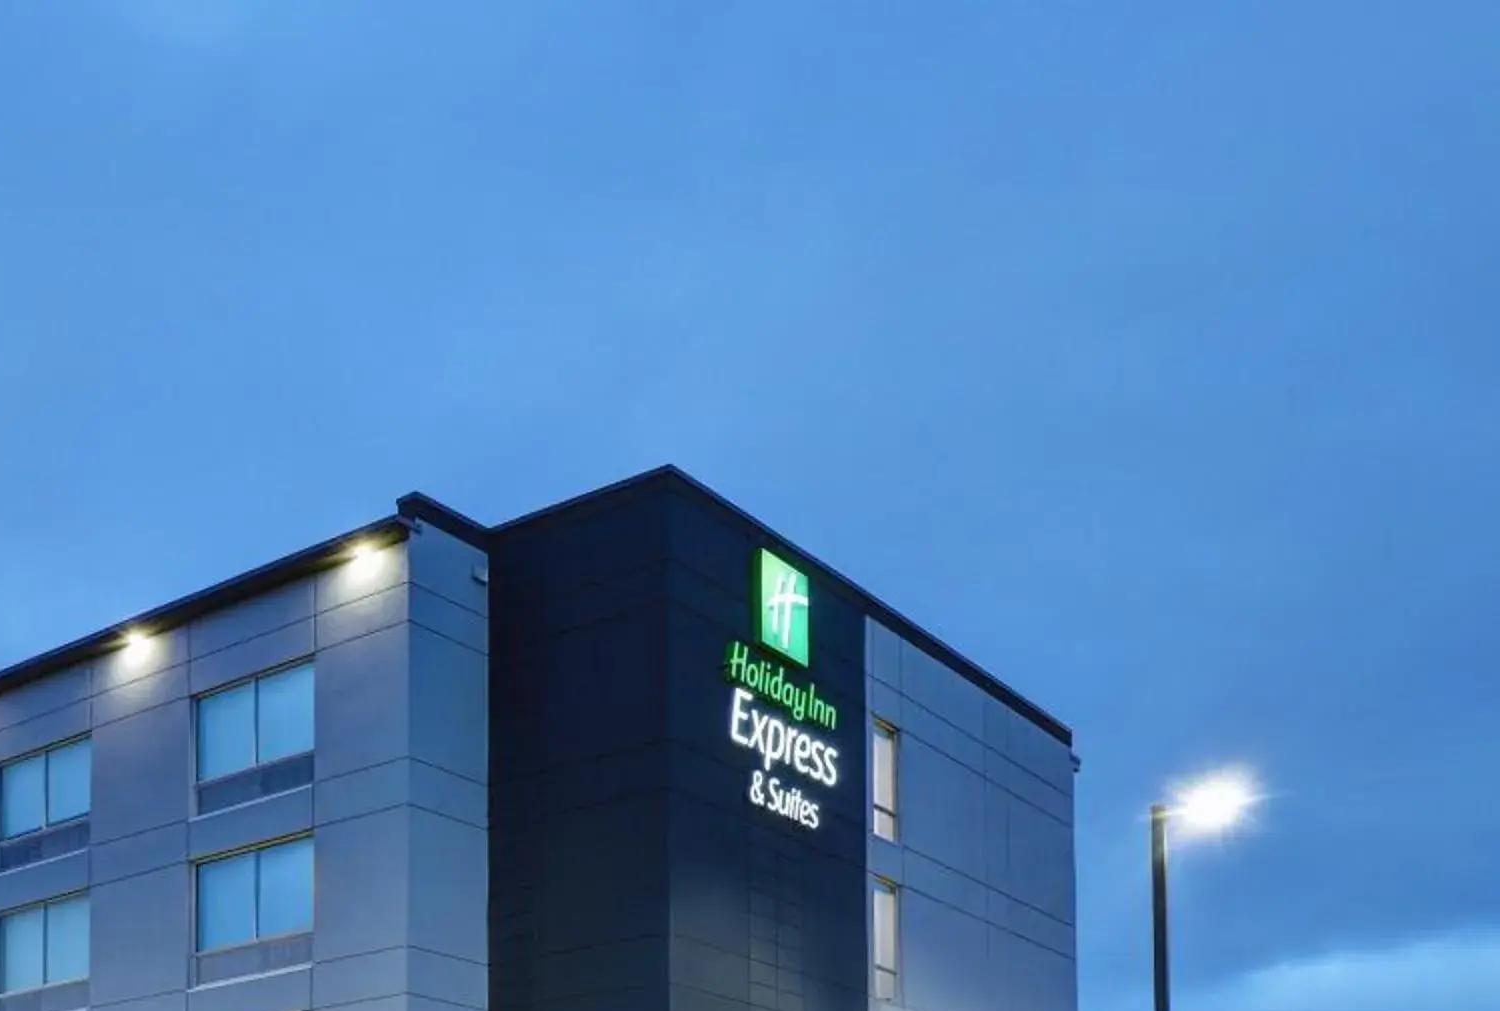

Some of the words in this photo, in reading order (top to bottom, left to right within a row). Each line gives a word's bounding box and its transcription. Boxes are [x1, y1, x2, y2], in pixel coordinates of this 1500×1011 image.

[729, 641, 806, 721] Holiday
[808, 683, 837, 731] Inn
[730, 687, 838, 792] Express
[749, 769, 765, 805] &
[767, 777, 820, 829] Suites
